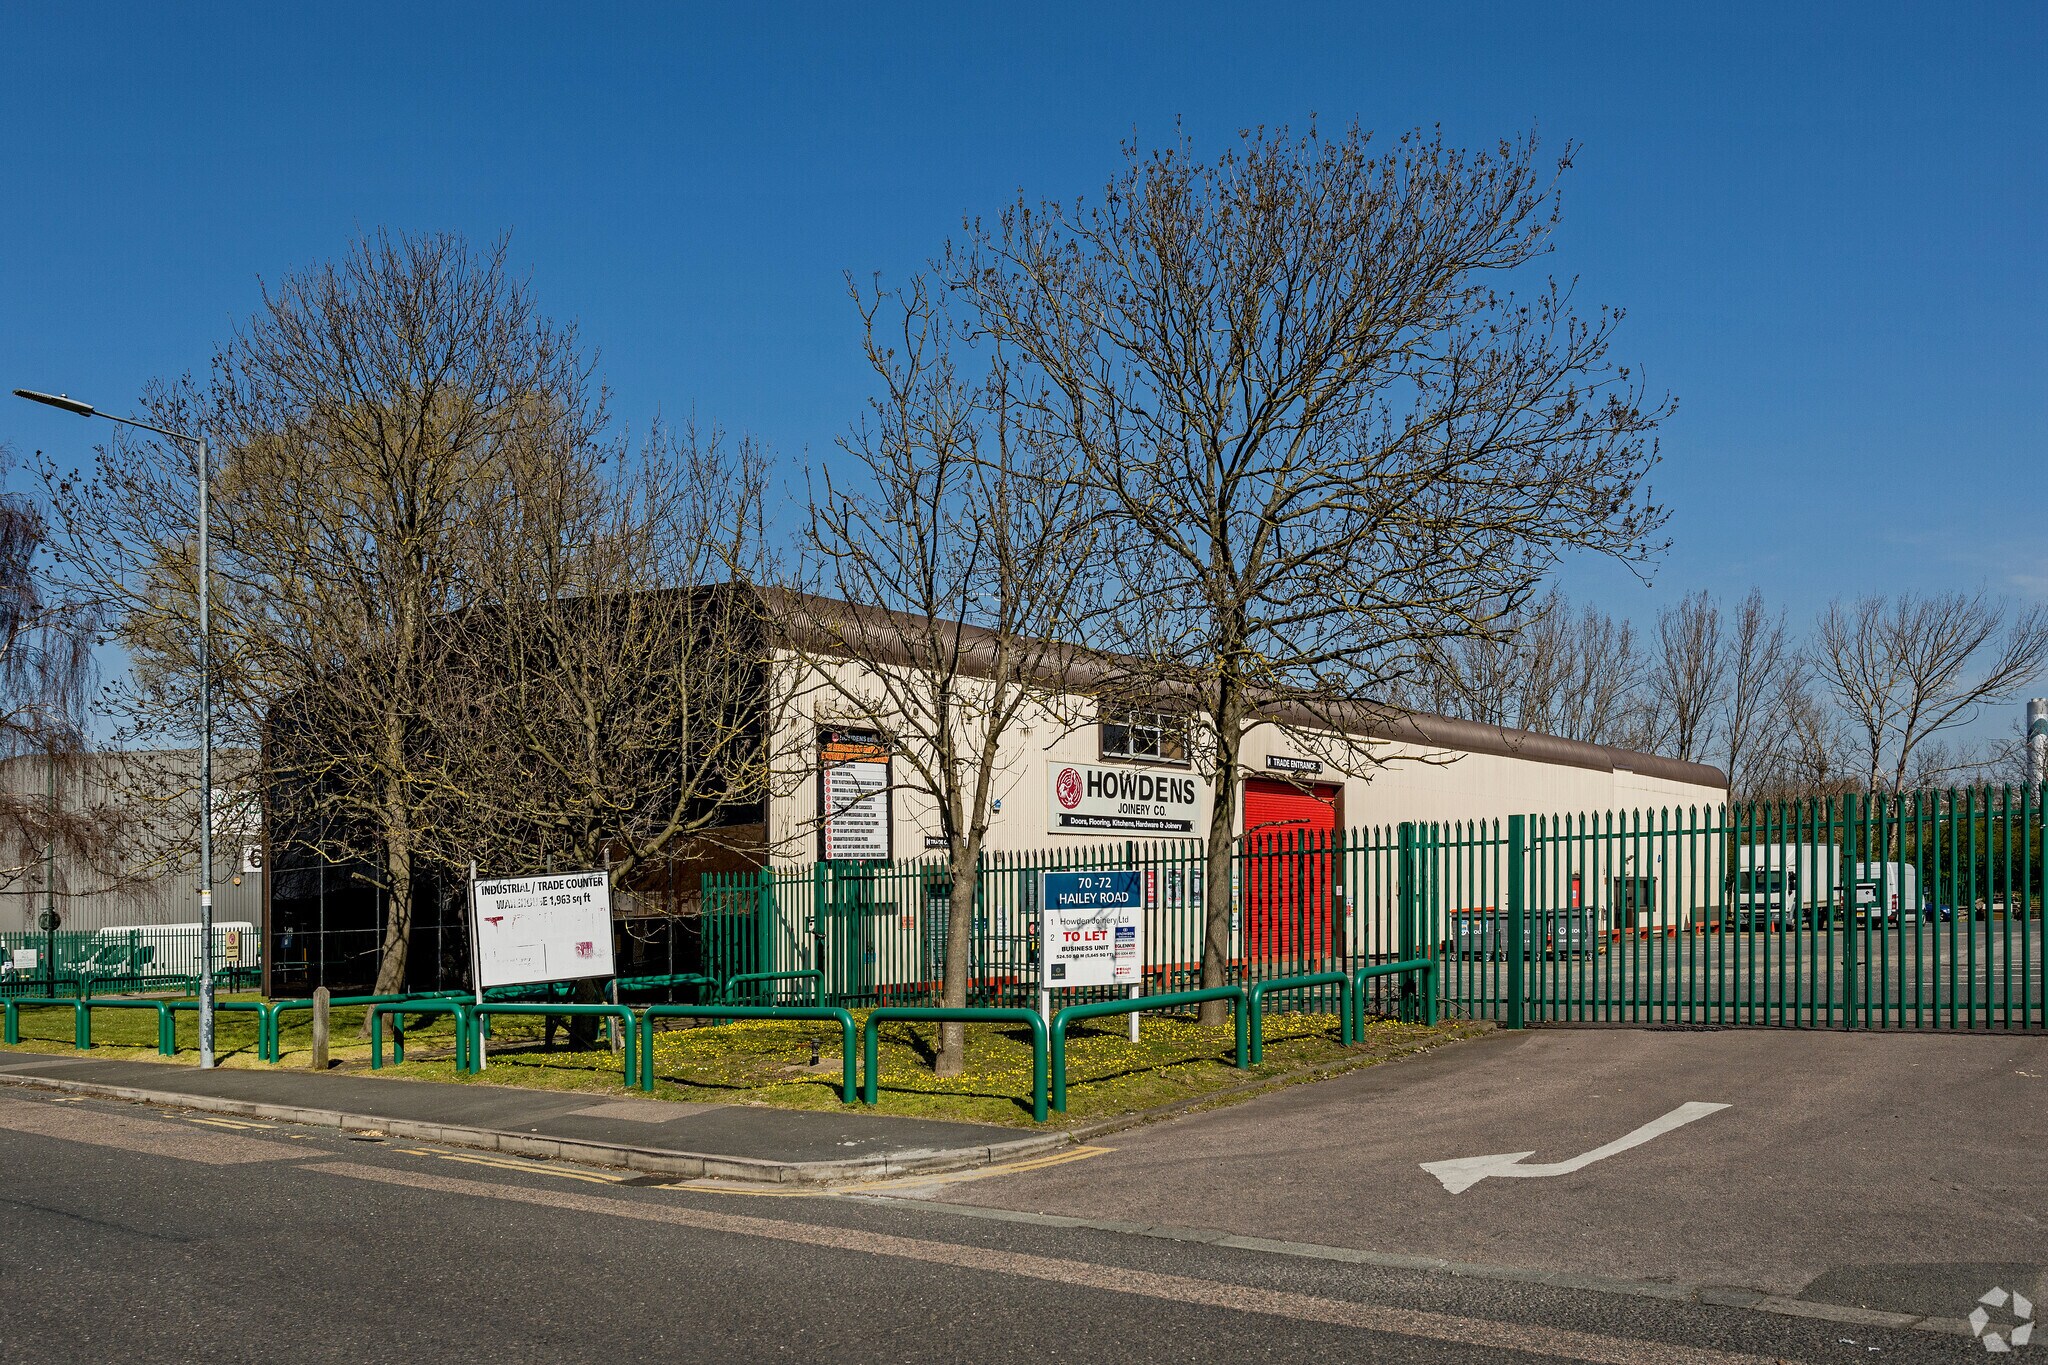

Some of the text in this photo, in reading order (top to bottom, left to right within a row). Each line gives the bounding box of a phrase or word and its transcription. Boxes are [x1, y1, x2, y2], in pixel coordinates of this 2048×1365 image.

[1273, 758, 1290, 768] TRADE
[1087, 770, 1195, 805] HOWDENS
[1118, 803, 1167, 817] JOINERY CO.
[1070, 817, 1088, 826] Doors,
[1088, 818, 1111, 827] Flooring,
[1112, 819, 1135, 828] Kitchens,
[1136, 820, 1159, 828] Hardware
[1164, 822, 1182, 830] Joinery
[482, 876, 604, 896] INDUSTRIAL / TRADE COUNTER
[1078, 878, 1112, 888] 70 -72
[550, 894, 571, 906] 1,963
[572, 896, 582, 906] sq
[583, 892, 591, 902] ft
[1059, 892, 1129, 904] HAILEY ROAD
[1092, 916, 1116, 925] Joinery
[1119, 916, 1129, 924] Ltd
[1063, 932, 1080, 942] TO
[1085, 931, 1107, 941] LET
